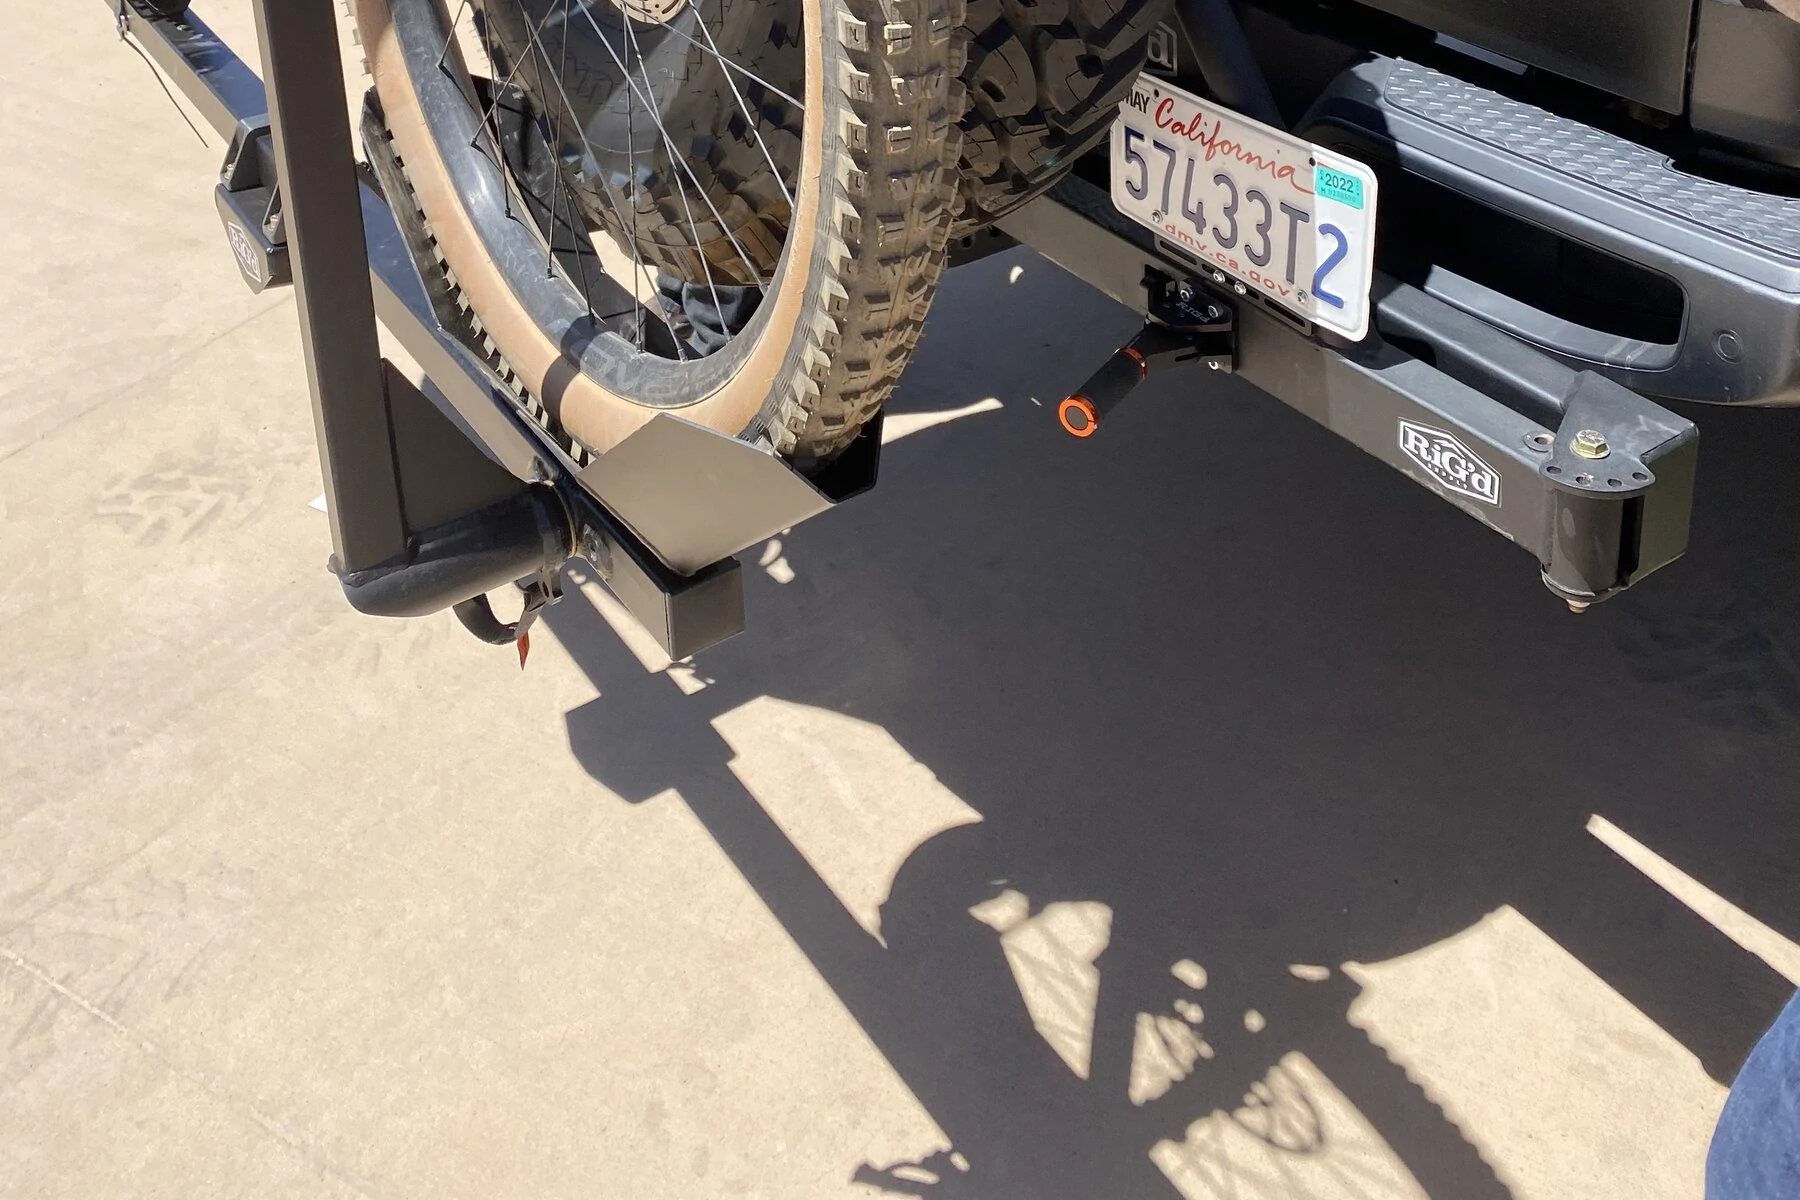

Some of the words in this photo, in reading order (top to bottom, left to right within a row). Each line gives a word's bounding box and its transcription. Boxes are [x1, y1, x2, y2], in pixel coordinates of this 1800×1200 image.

[1155, 97, 1315, 196] California
[1324, 172, 1354, 194] 2022
[1124, 126, 1348, 309] 57433T2
[1164, 222, 1291, 297] dmv.ca.gov
